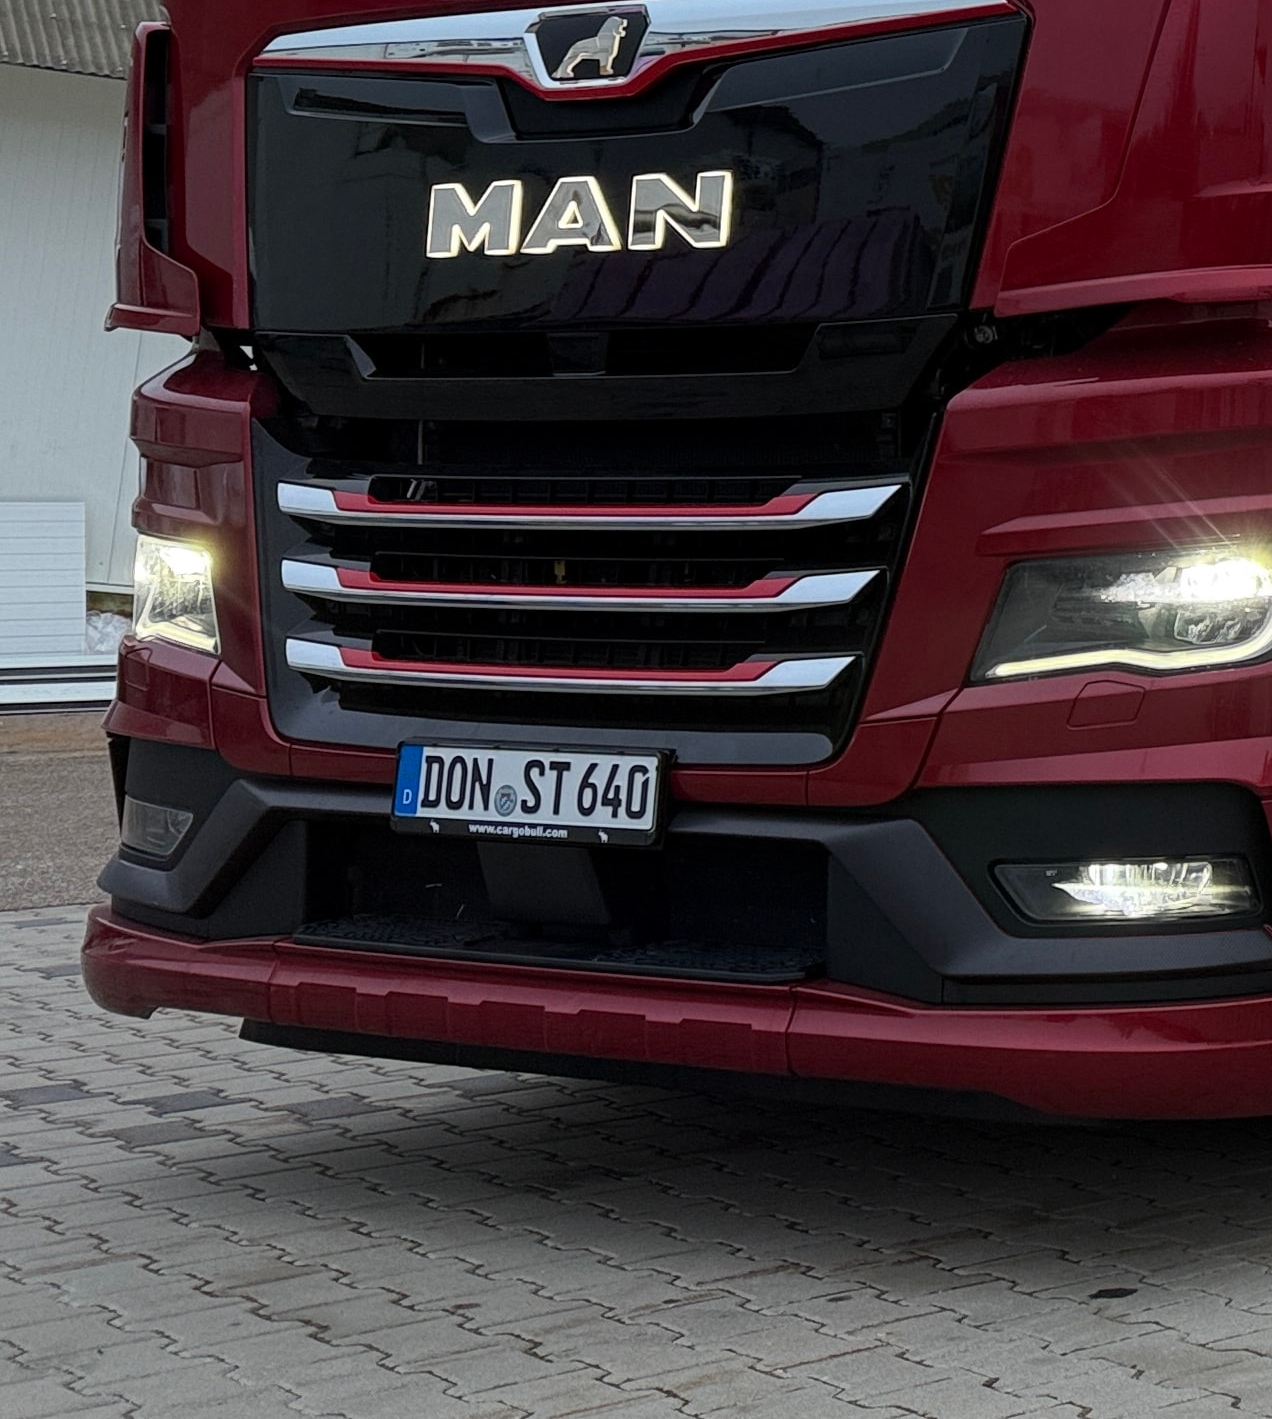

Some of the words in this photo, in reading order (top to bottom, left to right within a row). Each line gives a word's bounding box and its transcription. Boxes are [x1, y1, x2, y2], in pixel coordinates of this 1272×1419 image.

[425, 169, 734, 259] MAN
[402, 788, 412, 805] D
[420, 755, 494, 812] DON
[520, 760, 571, 816] ST
[577, 762, 651, 820] 640
[468, 823, 568, 839] www.cargobull.com
